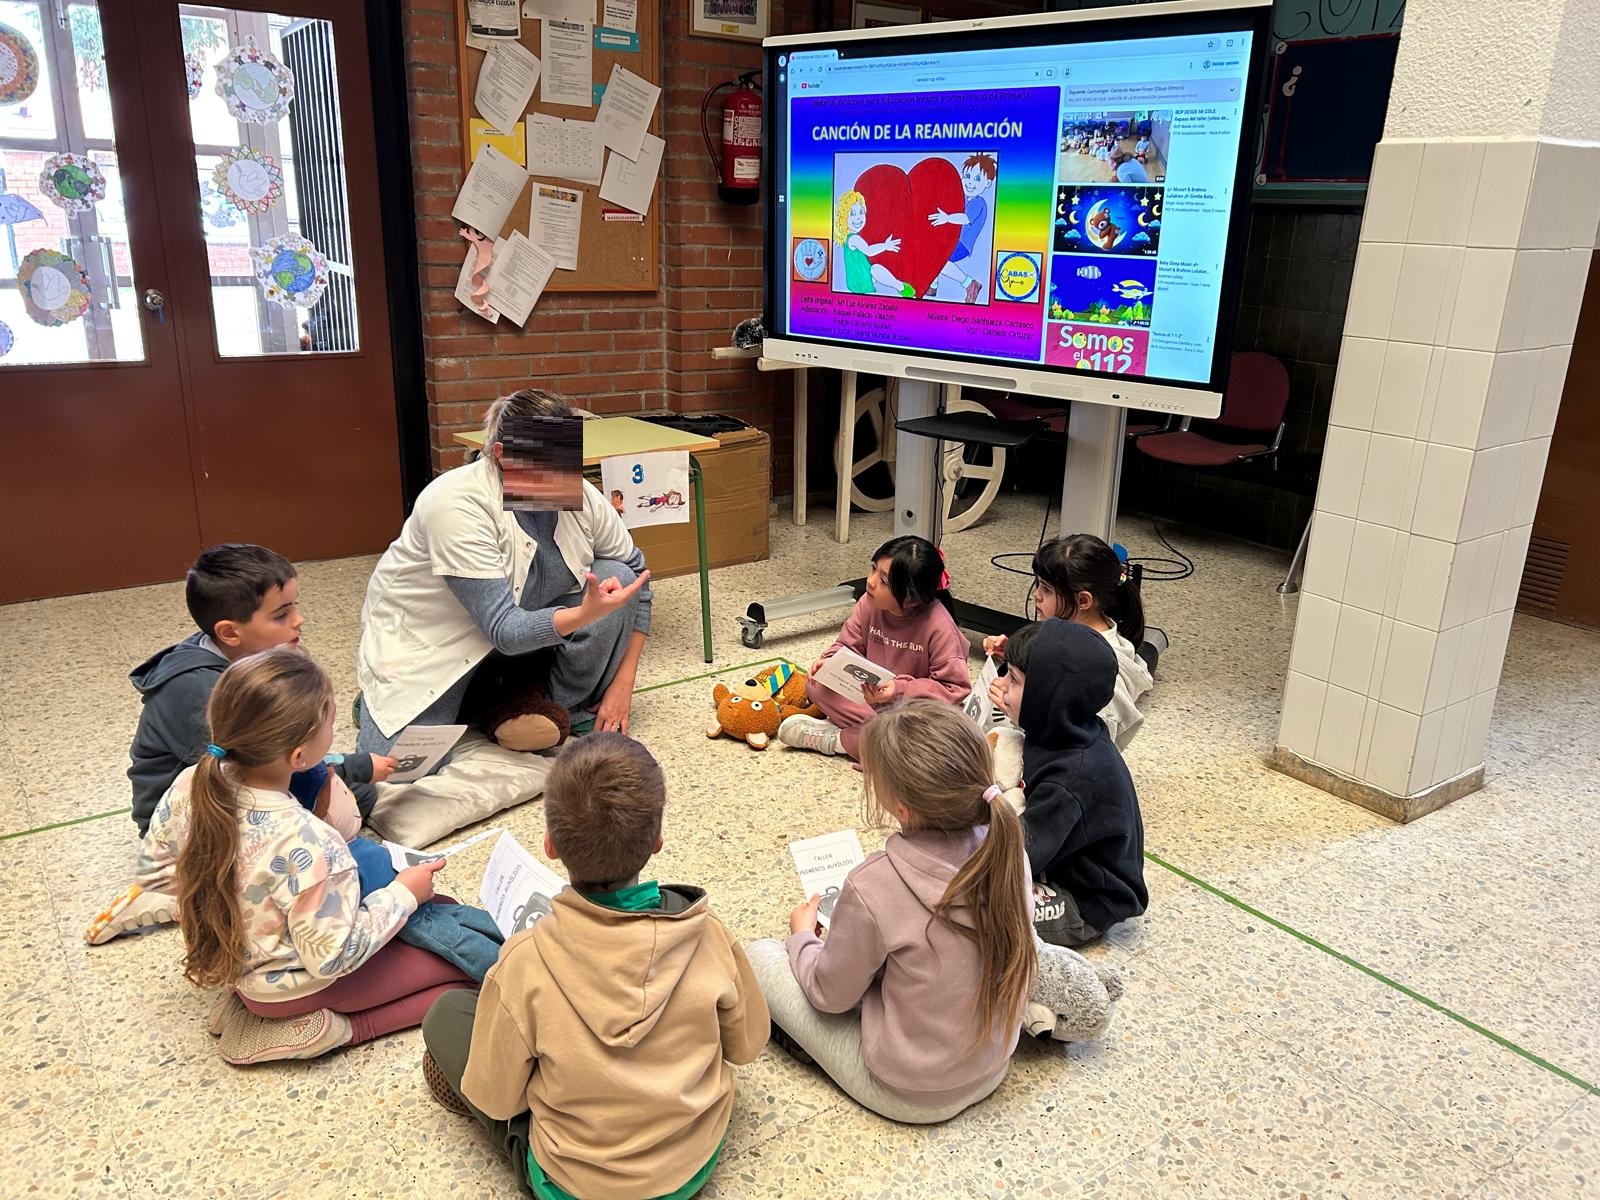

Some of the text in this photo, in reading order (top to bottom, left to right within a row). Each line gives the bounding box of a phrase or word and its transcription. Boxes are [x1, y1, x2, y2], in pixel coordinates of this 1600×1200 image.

[812, 117, 1023, 141] CANCIÓN DE LA REANIMACIÓN
[952, 313, 969, 324] Diego
[1059, 325, 1134, 354] Somos
[1090, 352, 1132, 374] 112
[632, 463, 645, 484] 3
[890, 639, 909, 649] THE
[909, 642, 924, 652] SUN
[827, 859, 854, 869] AUXILIOS
